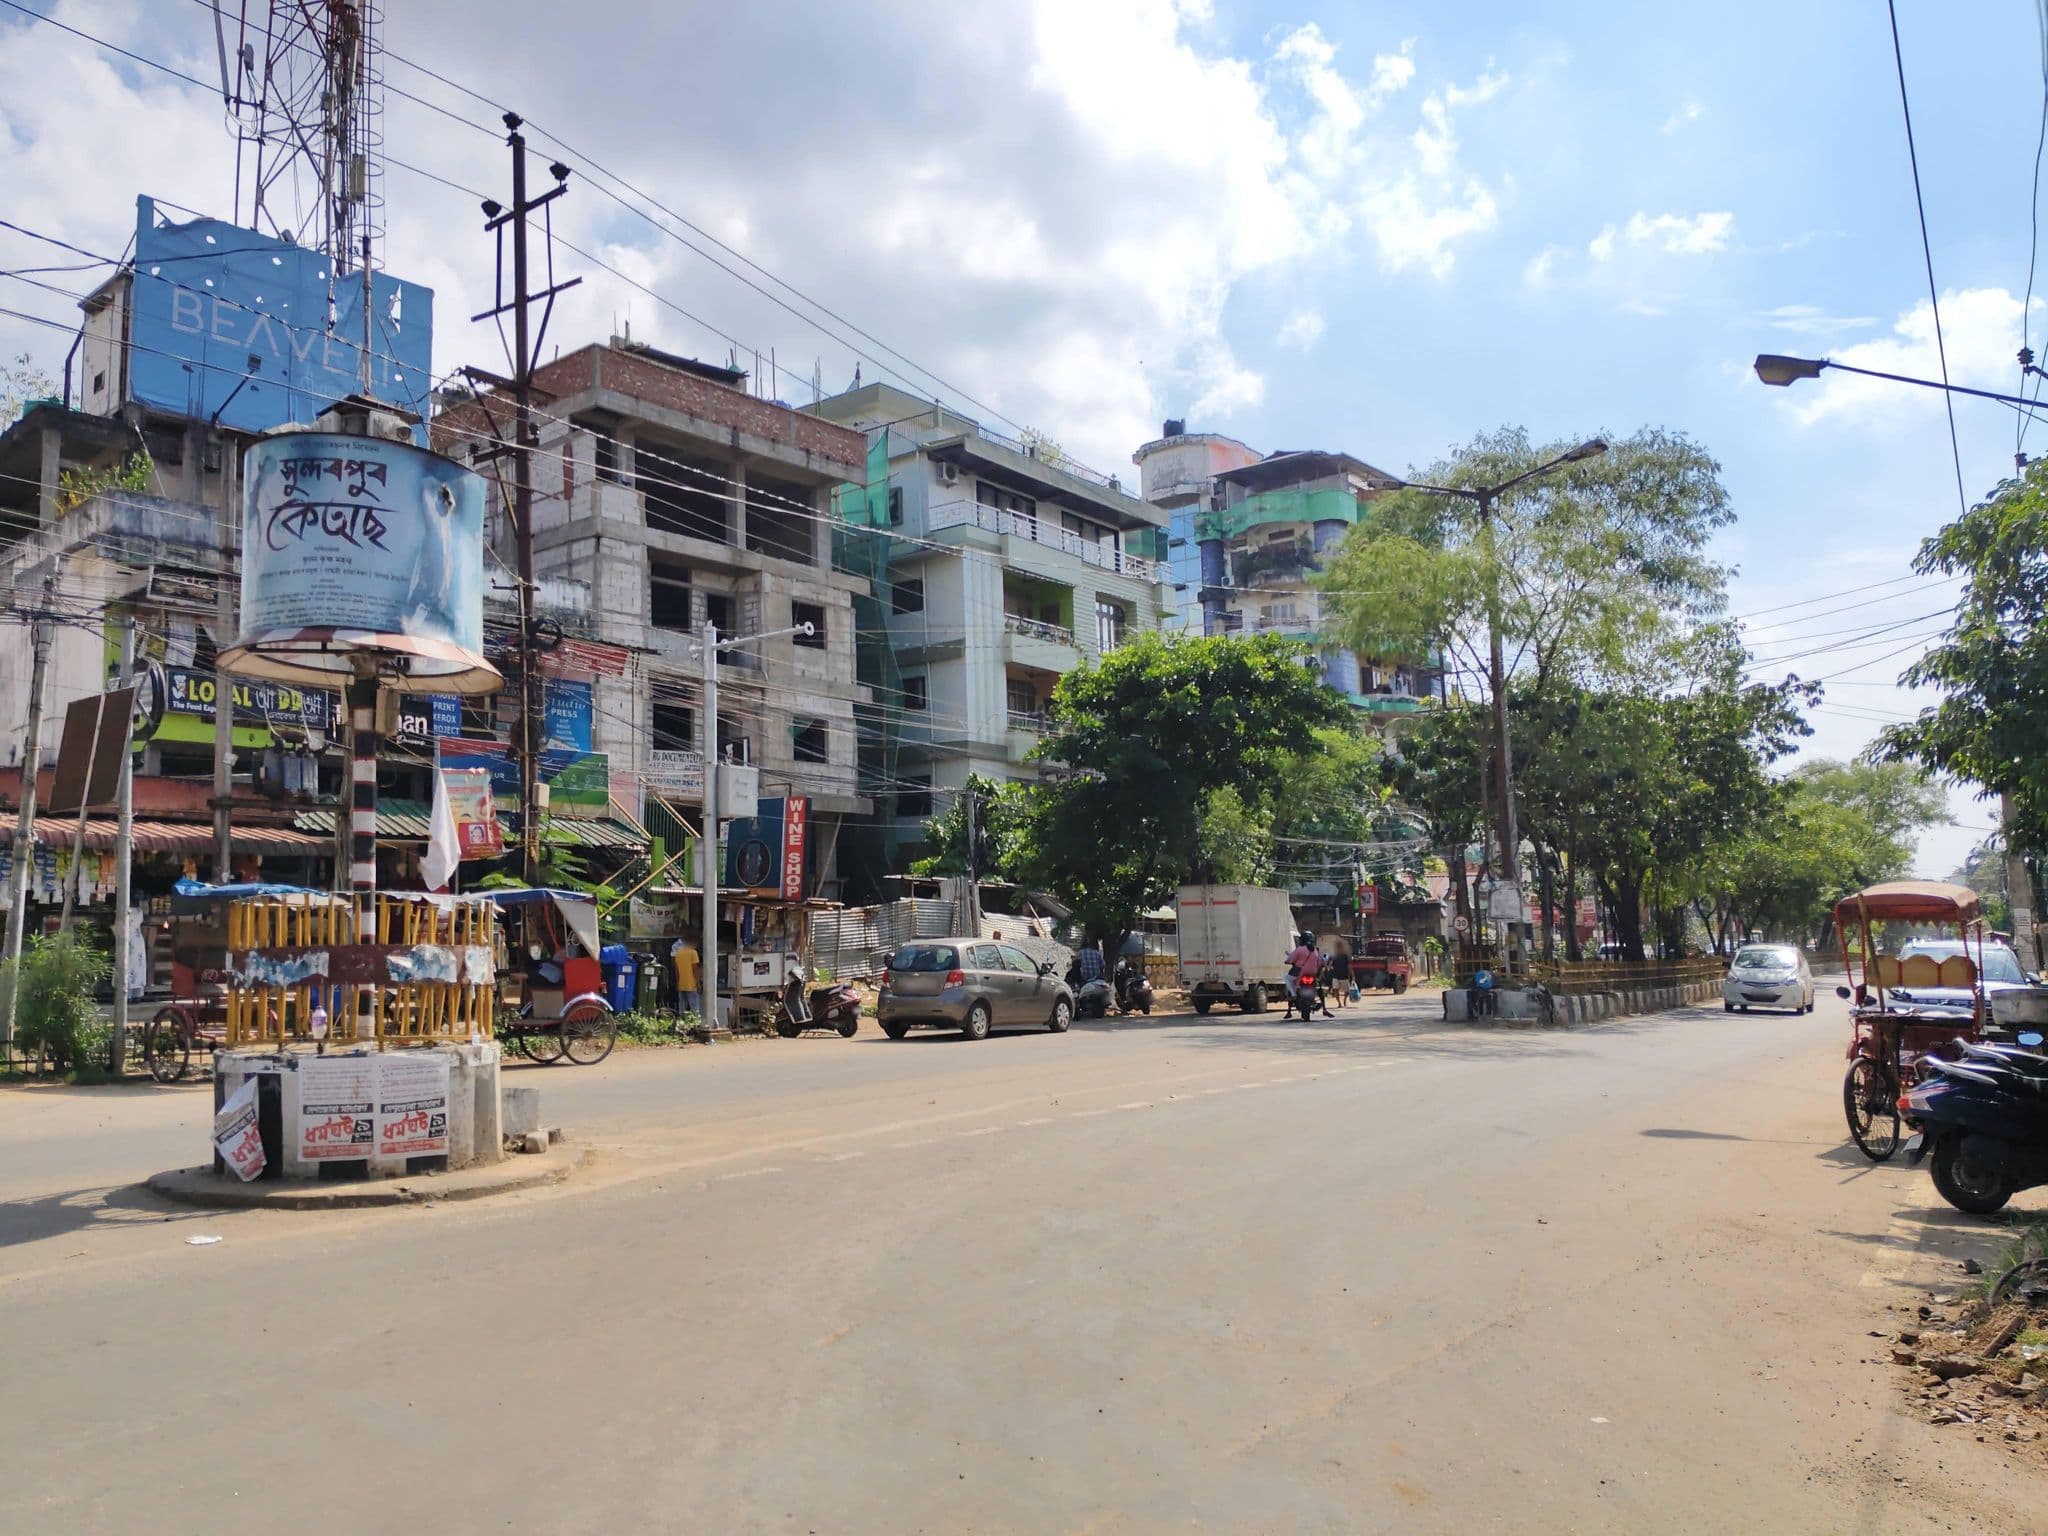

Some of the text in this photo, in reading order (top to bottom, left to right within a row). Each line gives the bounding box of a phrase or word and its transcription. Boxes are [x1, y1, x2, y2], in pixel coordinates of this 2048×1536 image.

[188, 679, 253, 708] LOAL
[433, 700, 456, 712] PRINT
[551, 708, 578, 719] PRESS
[433, 724, 460, 735] ROJECT
[789, 799, 804, 846] WINE
[786, 853, 801, 897] SHOP
[1457, 919, 1467, 927] 30
